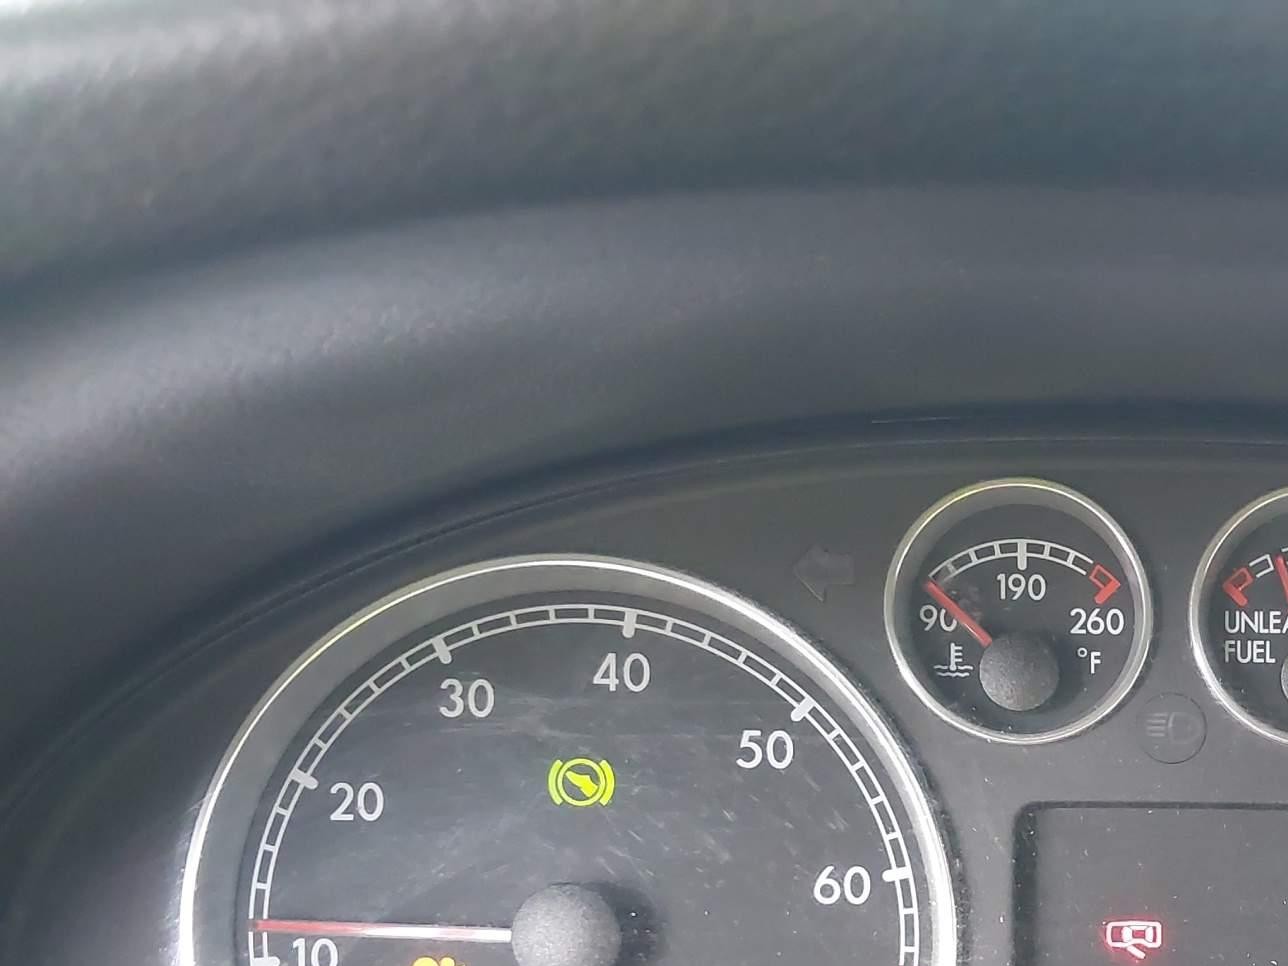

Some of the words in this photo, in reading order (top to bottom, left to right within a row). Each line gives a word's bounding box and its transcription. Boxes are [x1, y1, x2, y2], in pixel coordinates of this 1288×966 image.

[996, 573, 1046, 601] 190
[919, 604, 958, 632] 90
[1070, 607, 1125, 635] 260
[1224, 640, 1276, 663] FUEL
[592, 652, 651, 693] 40
[439, 678, 495, 718] 30
[735, 729, 794, 770] 50
[329, 782, 384, 822] 20
[813, 865, 871, 905] 60
